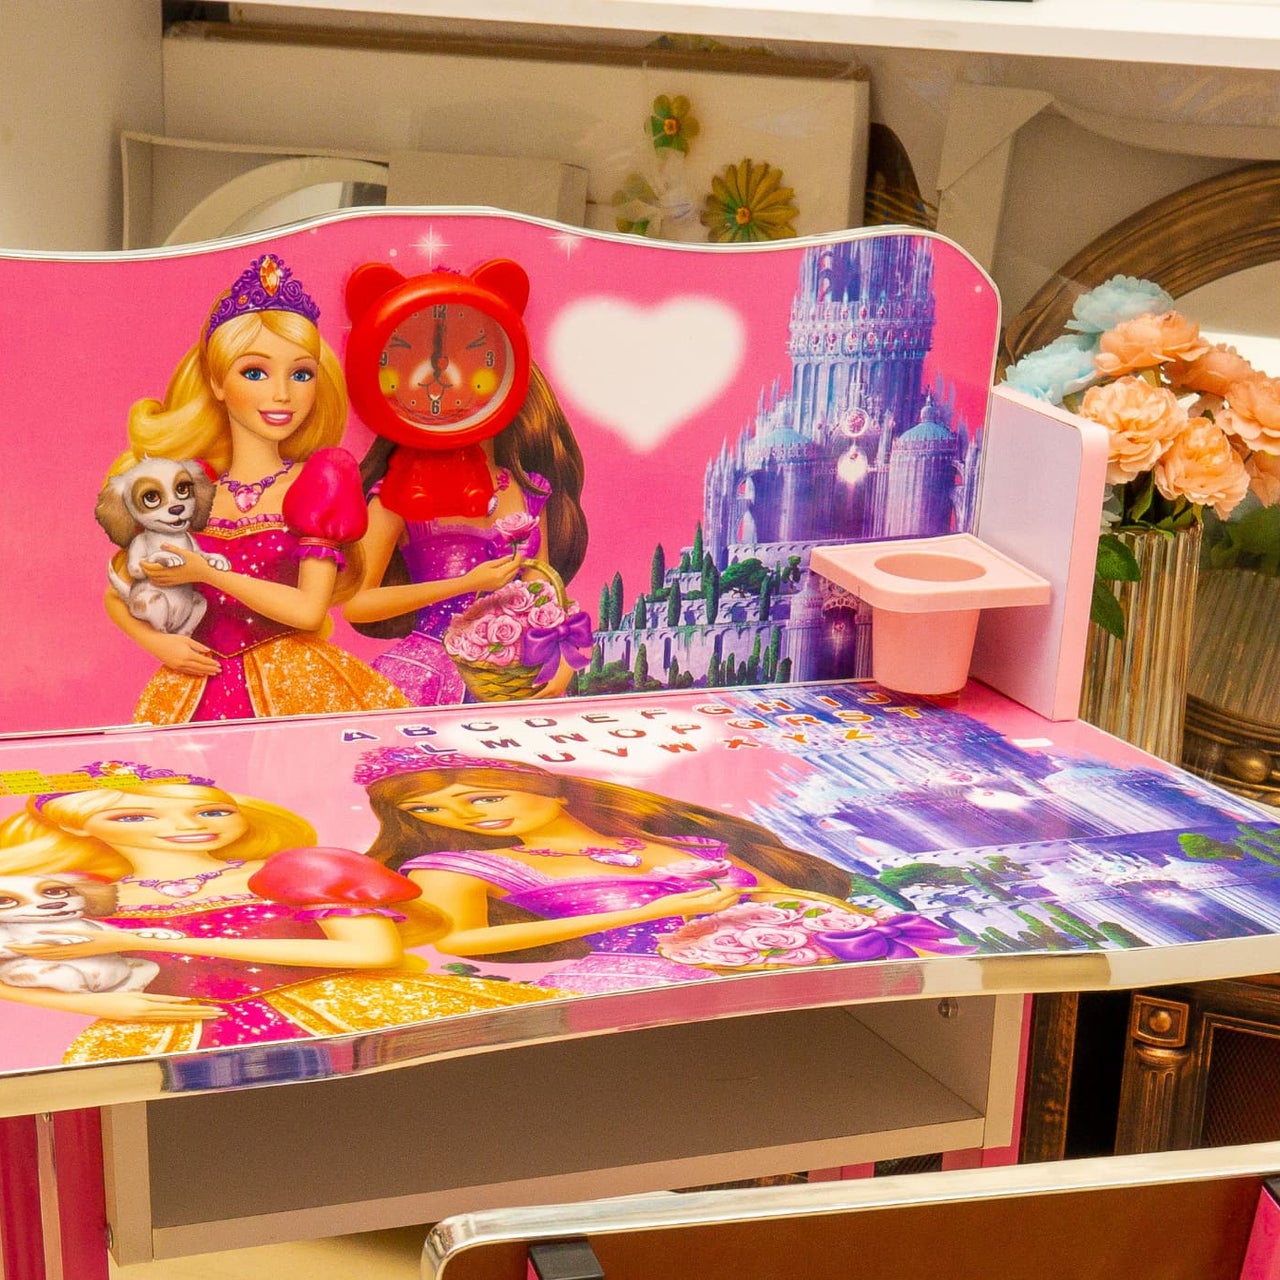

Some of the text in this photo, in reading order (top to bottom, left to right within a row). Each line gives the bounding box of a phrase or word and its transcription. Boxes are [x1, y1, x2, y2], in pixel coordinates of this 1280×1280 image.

[433, 304, 447, 318] 12
[380, 351, 494, 367] 9 3
[431, 400, 439, 415] 6
[343, 692, 891, 742] A B C D E F G H I J
[419, 705, 922, 754] L M N O P Q R S T
[537, 728, 875, 763] U V W X Y Z
